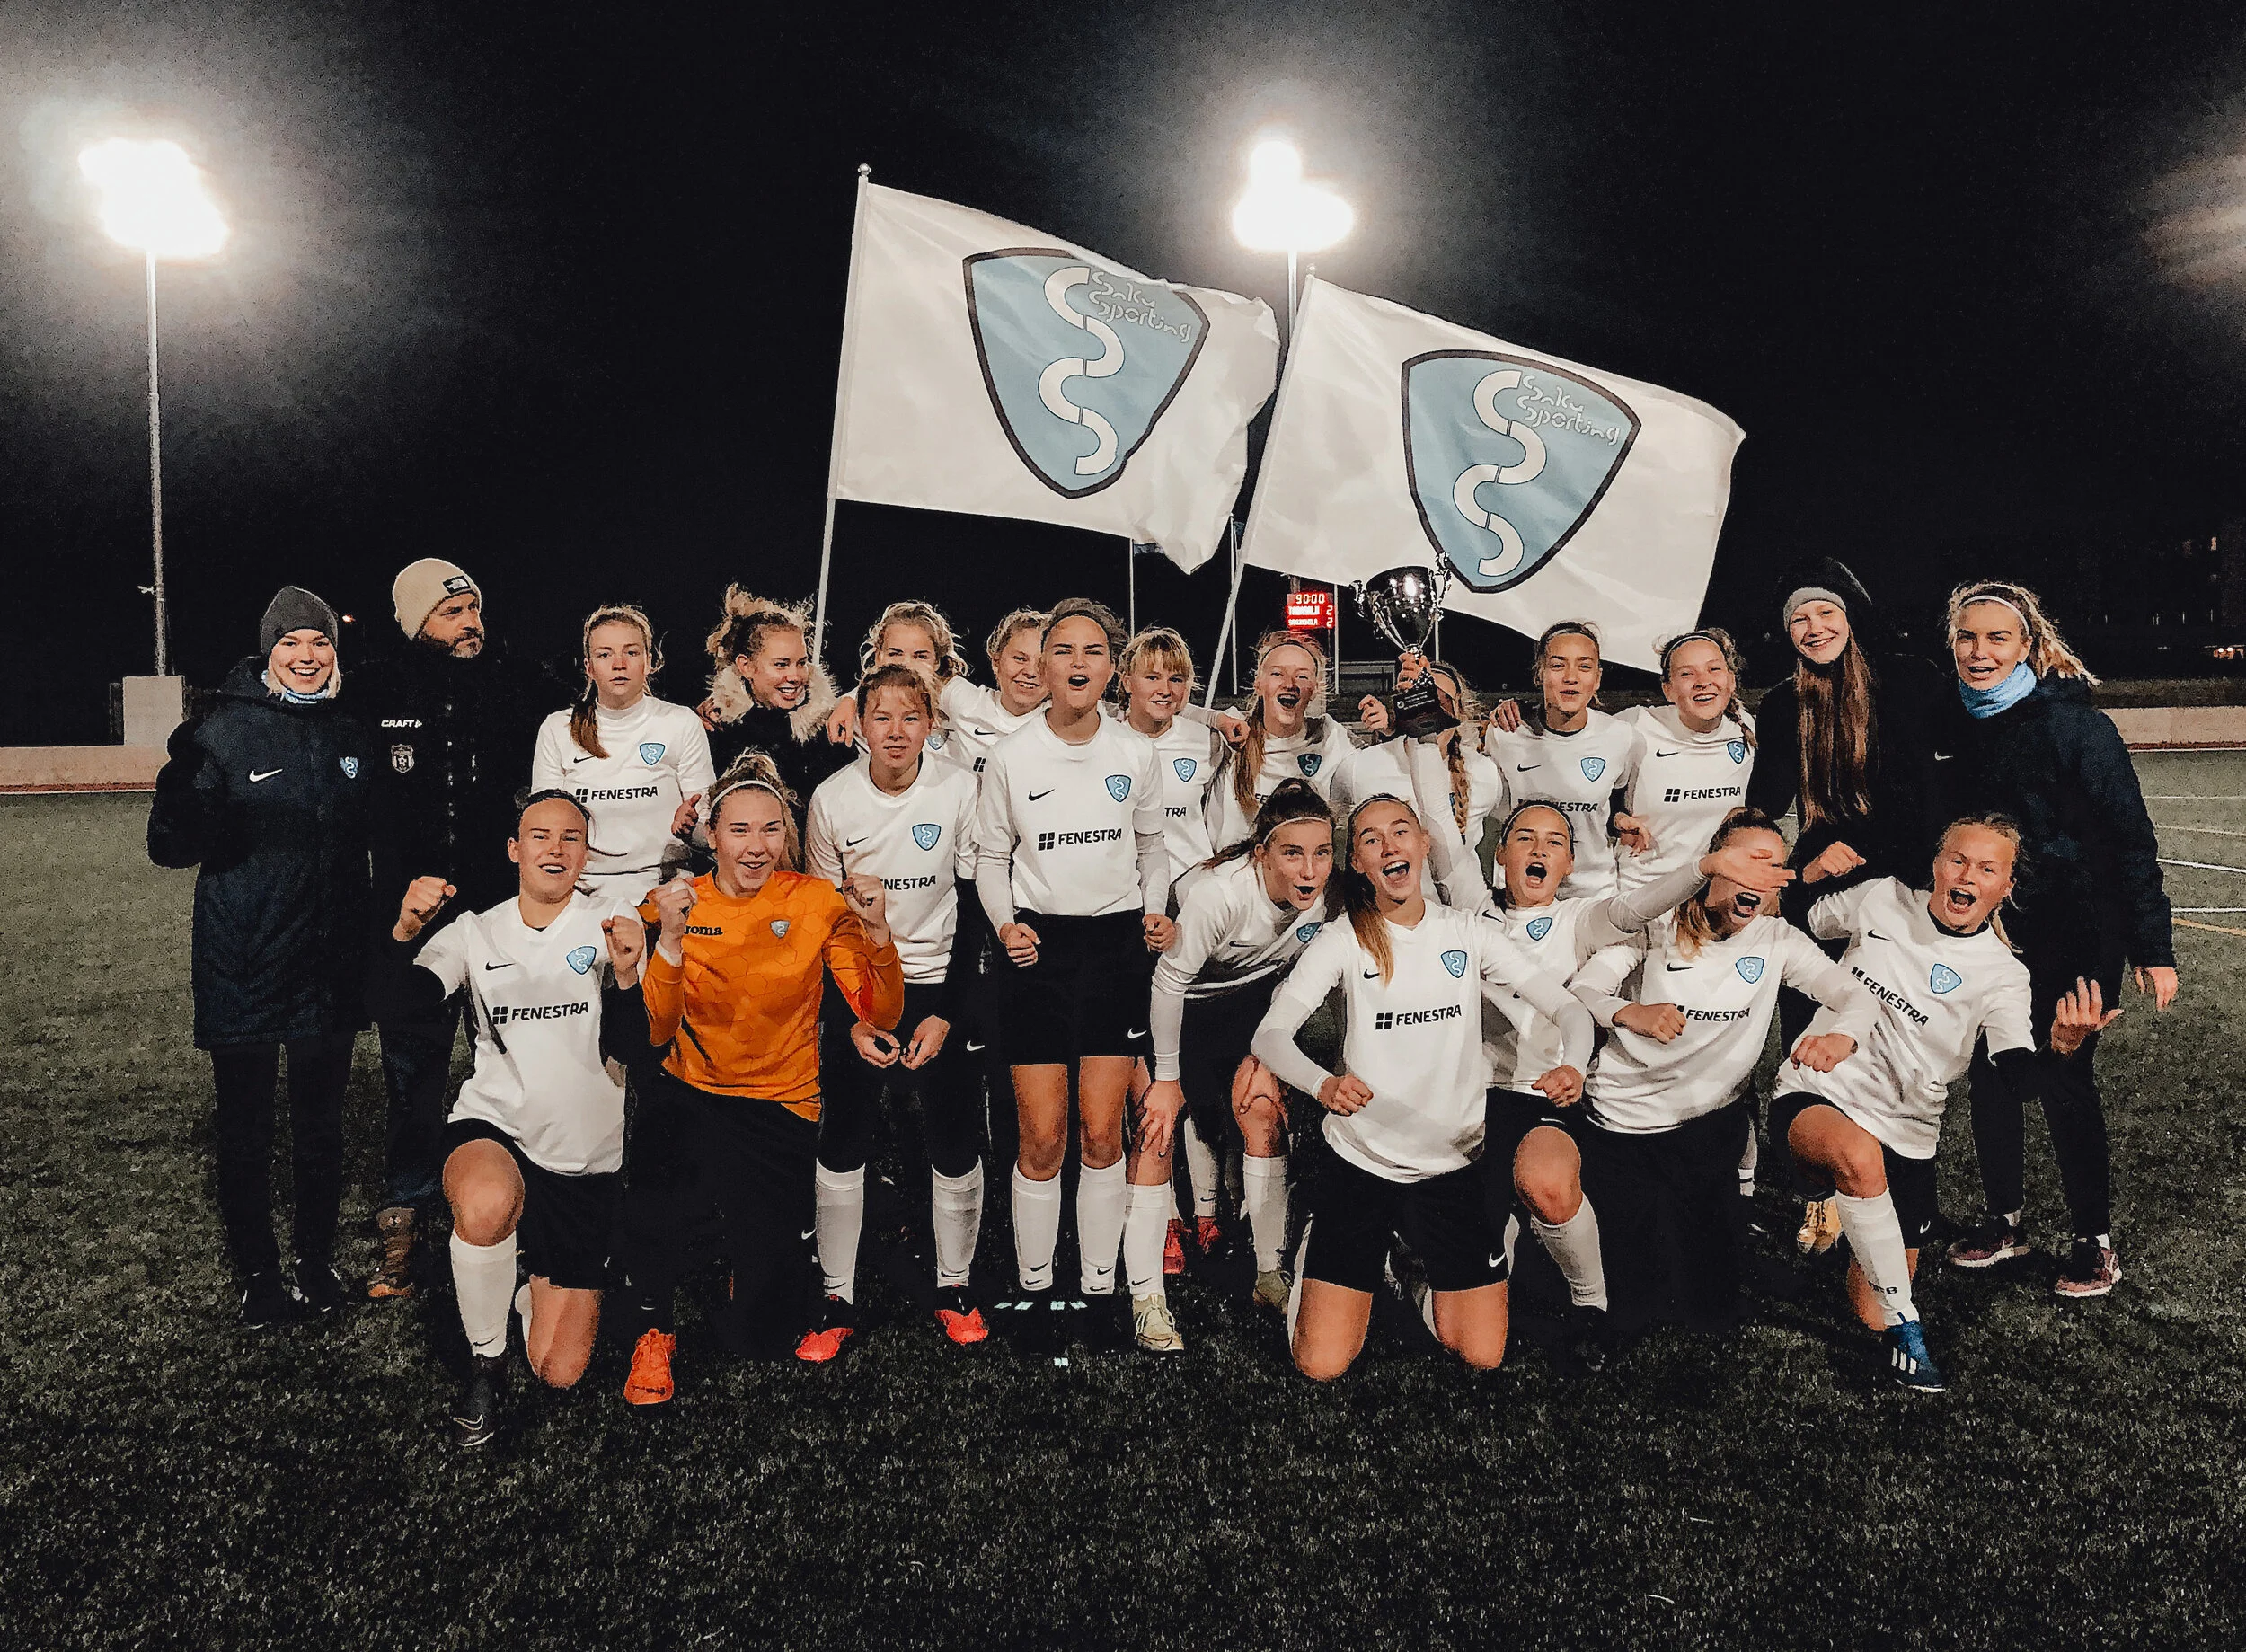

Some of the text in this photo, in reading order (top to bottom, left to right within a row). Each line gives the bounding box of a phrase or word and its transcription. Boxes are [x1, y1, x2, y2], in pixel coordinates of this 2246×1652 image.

[1088, 290, 1192, 343] Sporting
[1516, 395, 1621, 446] Sporting
[1326, 605, 1333, 615] 2
[1326, 617, 1333, 627] 2
[381, 720, 414, 728] CRAFT
[591, 786, 659, 800] FENESTRA
[1683, 786, 1741, 800] FENESTRA
[1556, 802, 1598, 813] ESTRA
[1058, 828, 1122, 845] FENESTRA
[880, 875, 936, 890] NESTRA
[1863, 976, 1929, 1027] FENESTRA
[511, 1001, 589, 1020] FENESTRA
[1395, 1004, 1462, 1026] FENESTRA
[1685, 1007, 1751, 1022] FENESTRA
